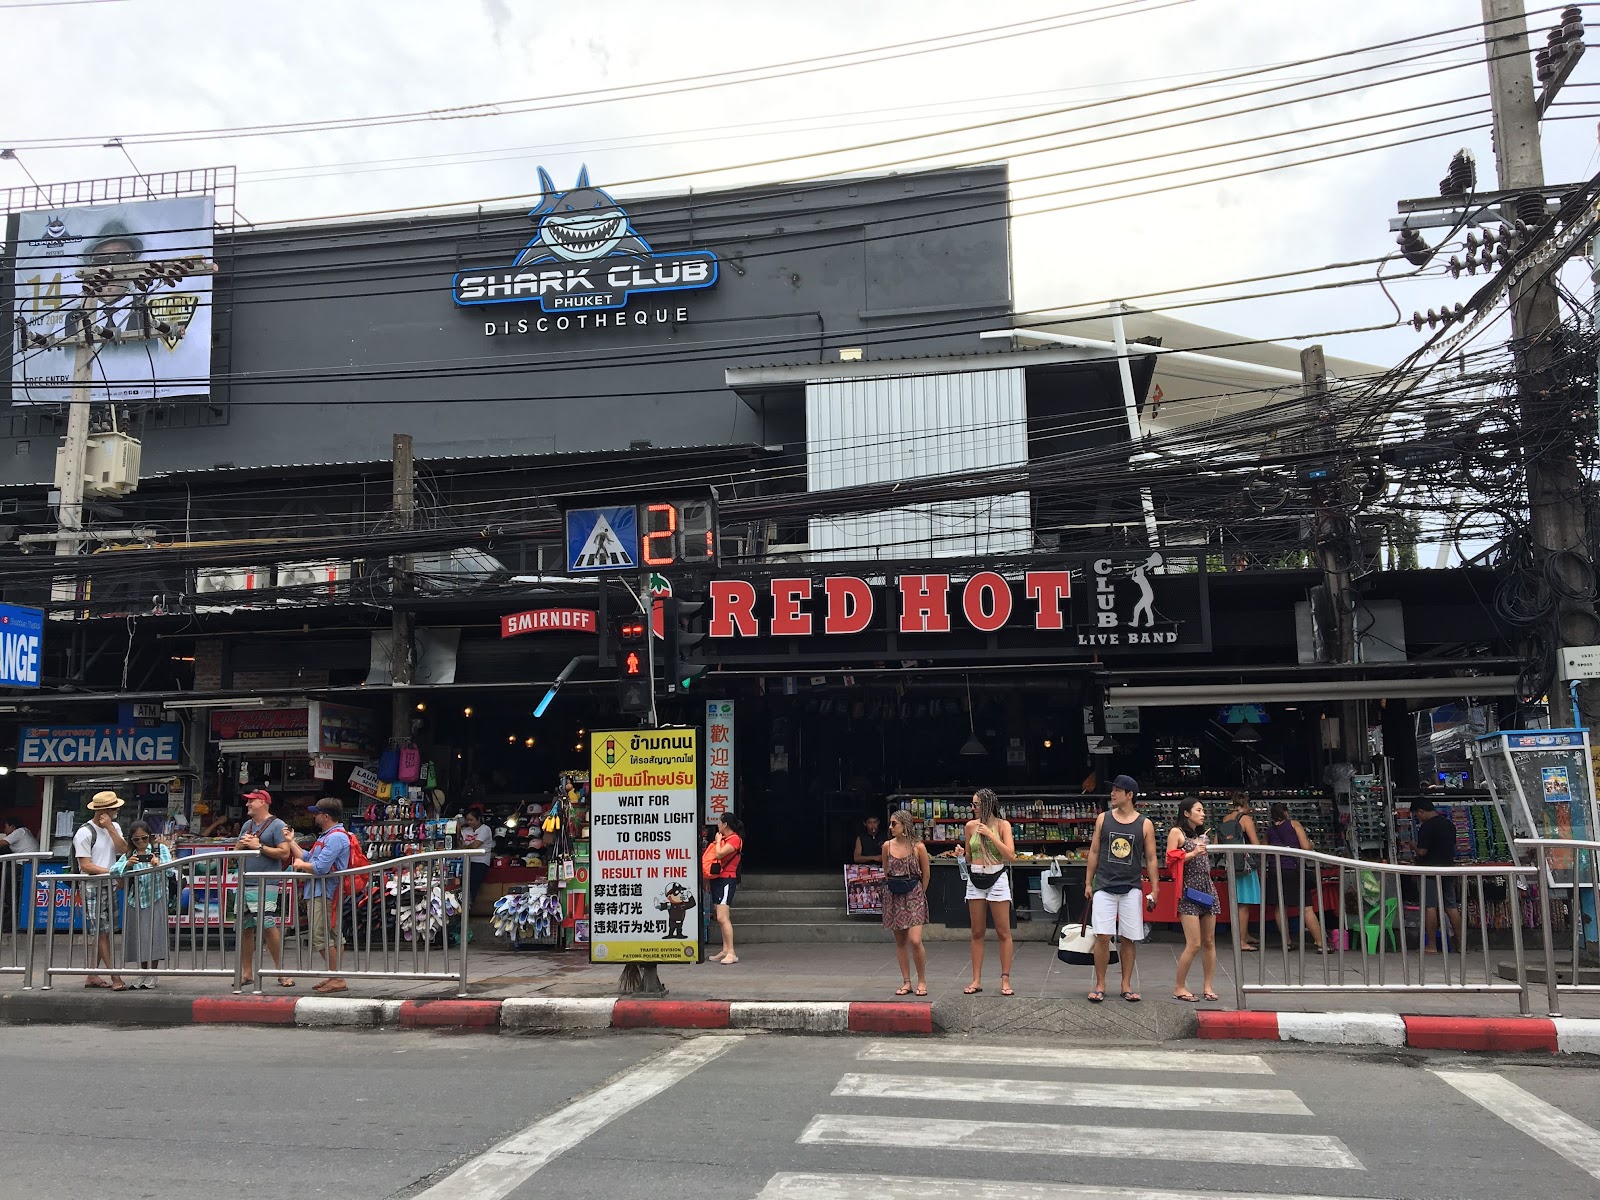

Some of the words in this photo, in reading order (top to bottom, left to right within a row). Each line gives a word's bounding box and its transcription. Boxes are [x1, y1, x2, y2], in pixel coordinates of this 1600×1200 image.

[459, 269, 594, 298] SHARK
[607, 260, 708, 287] CLUB
[27, 273, 62, 315] 14
[554, 295, 613, 308] PHUKET
[485, 308, 688, 336] DISCOTHEQUE
[46, 375, 69, 385] ENTRY
[643, 504, 713, 564] 21
[1094, 558, 1119, 628] CLUB
[709, 576, 874, 637] RED
[899, 570, 1071, 632] HOT
[508, 611, 590, 633] SMIRNOFF
[1078, 634, 1119, 645] LIVE
[1128, 632, 1178, 644] BAND
[138, 706, 157, 716] ATM
[52, 728, 96, 738] currency
[237, 730, 259, 738] Tour
[630, 734, 693, 750] ข้ามถนน
[23, 736, 174, 763] EXCHANGE
[710, 724, 730, 814] 歡迎遊客
[150, 784, 168, 795] UO
[618, 796, 644, 807] WAIT
[648, 795, 670, 806] FOR
[594, 813, 659, 825] PEDESTRIAN
[664, 812, 695, 824] LIGHT
[617, 832, 630, 843] TO
[635, 831, 671, 842] CROSS
[597, 849, 661, 861] VIOLATIONS
[666, 848, 691, 860] WILL
[602, 867, 642, 879] RESULT
[647, 867, 659, 879] IN
[663, 866, 687, 878] FINE
[594, 883, 642, 897] 穿过街道
[594, 902, 642, 915] 等待灯光
[594, 920, 667, 934] 违规行为处罚
